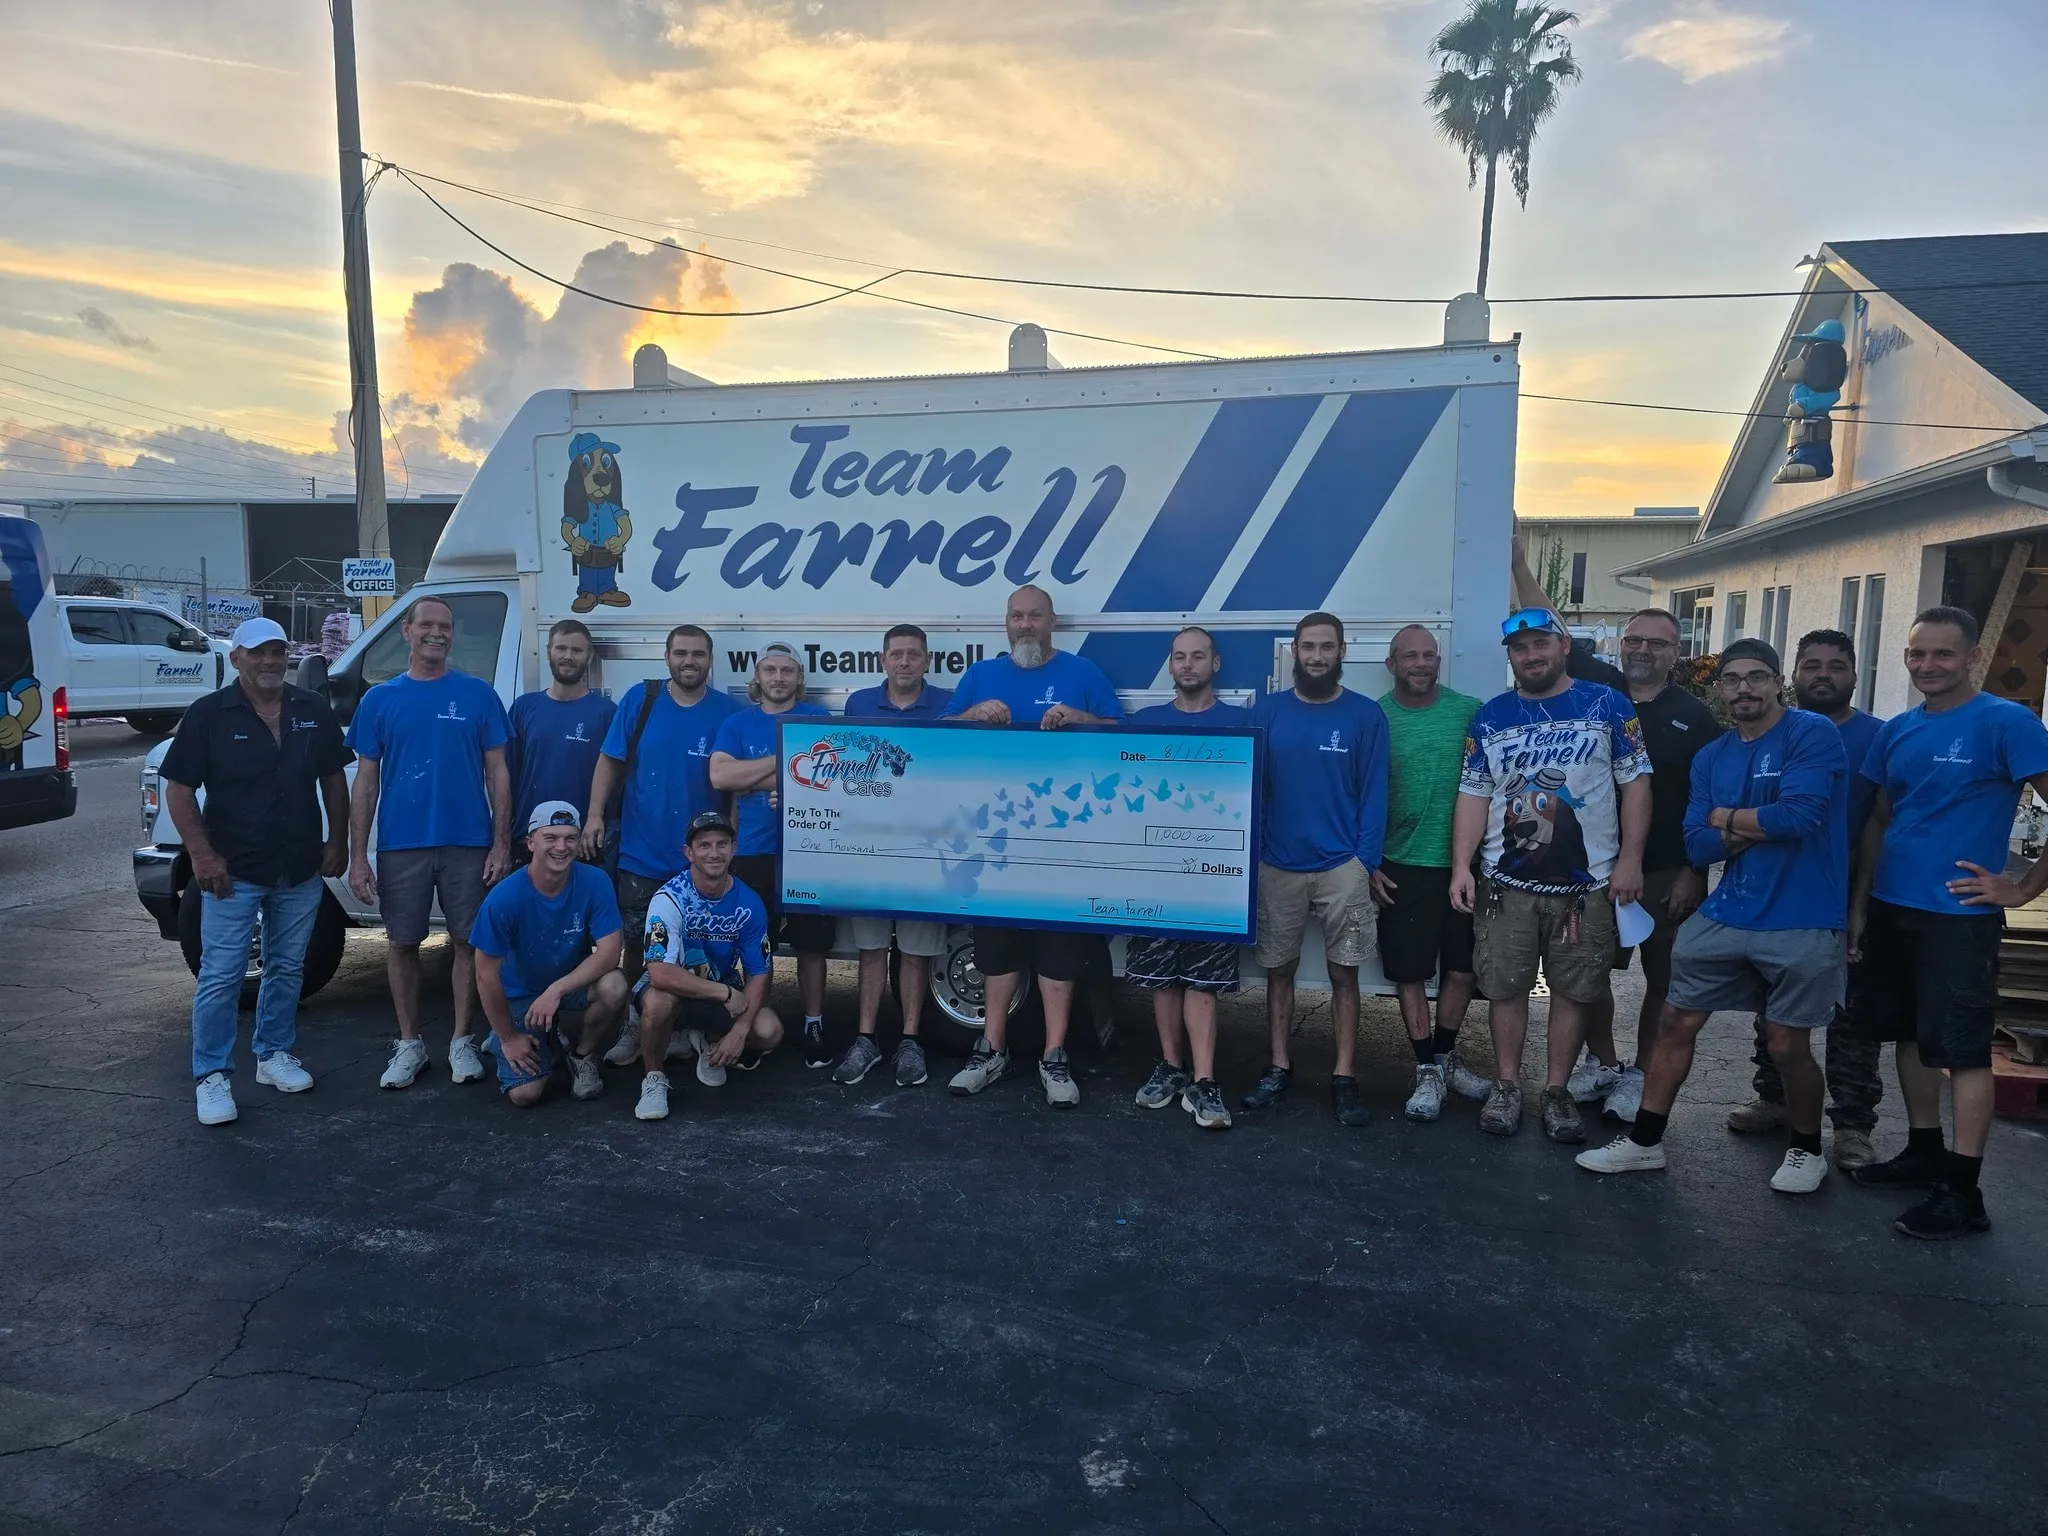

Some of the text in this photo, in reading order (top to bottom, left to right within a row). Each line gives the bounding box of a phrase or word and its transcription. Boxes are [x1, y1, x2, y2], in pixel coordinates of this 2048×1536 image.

[790, 424, 1012, 499] Team
[651, 465, 1126, 592] Farrell
[345, 563, 393, 577] Farrell
[360, 559, 381, 567] TEAM
[352, 580, 394, 590] OFFICE
[218, 598, 259, 616] Farrell
[156, 663, 203, 676] Farrell
[1523, 727, 1579, 747] Team
[1120, 751, 1147, 761] Date
[1164, 743, 1226, 760] 8/1/25
[1500, 738, 1598, 773] Farrell
[811, 745, 882, 785] Farrell
[843, 778, 893, 797] Cares
[788, 807, 807, 818] Pay
[809, 808, 821, 818] To
[788, 819, 831, 830] Order Of
[800, 837, 821, 850] One
[1202, 863, 1243, 875] Dollars
[787, 889, 817, 900] Memo
[1087, 897, 1163, 917] Team Farrell
